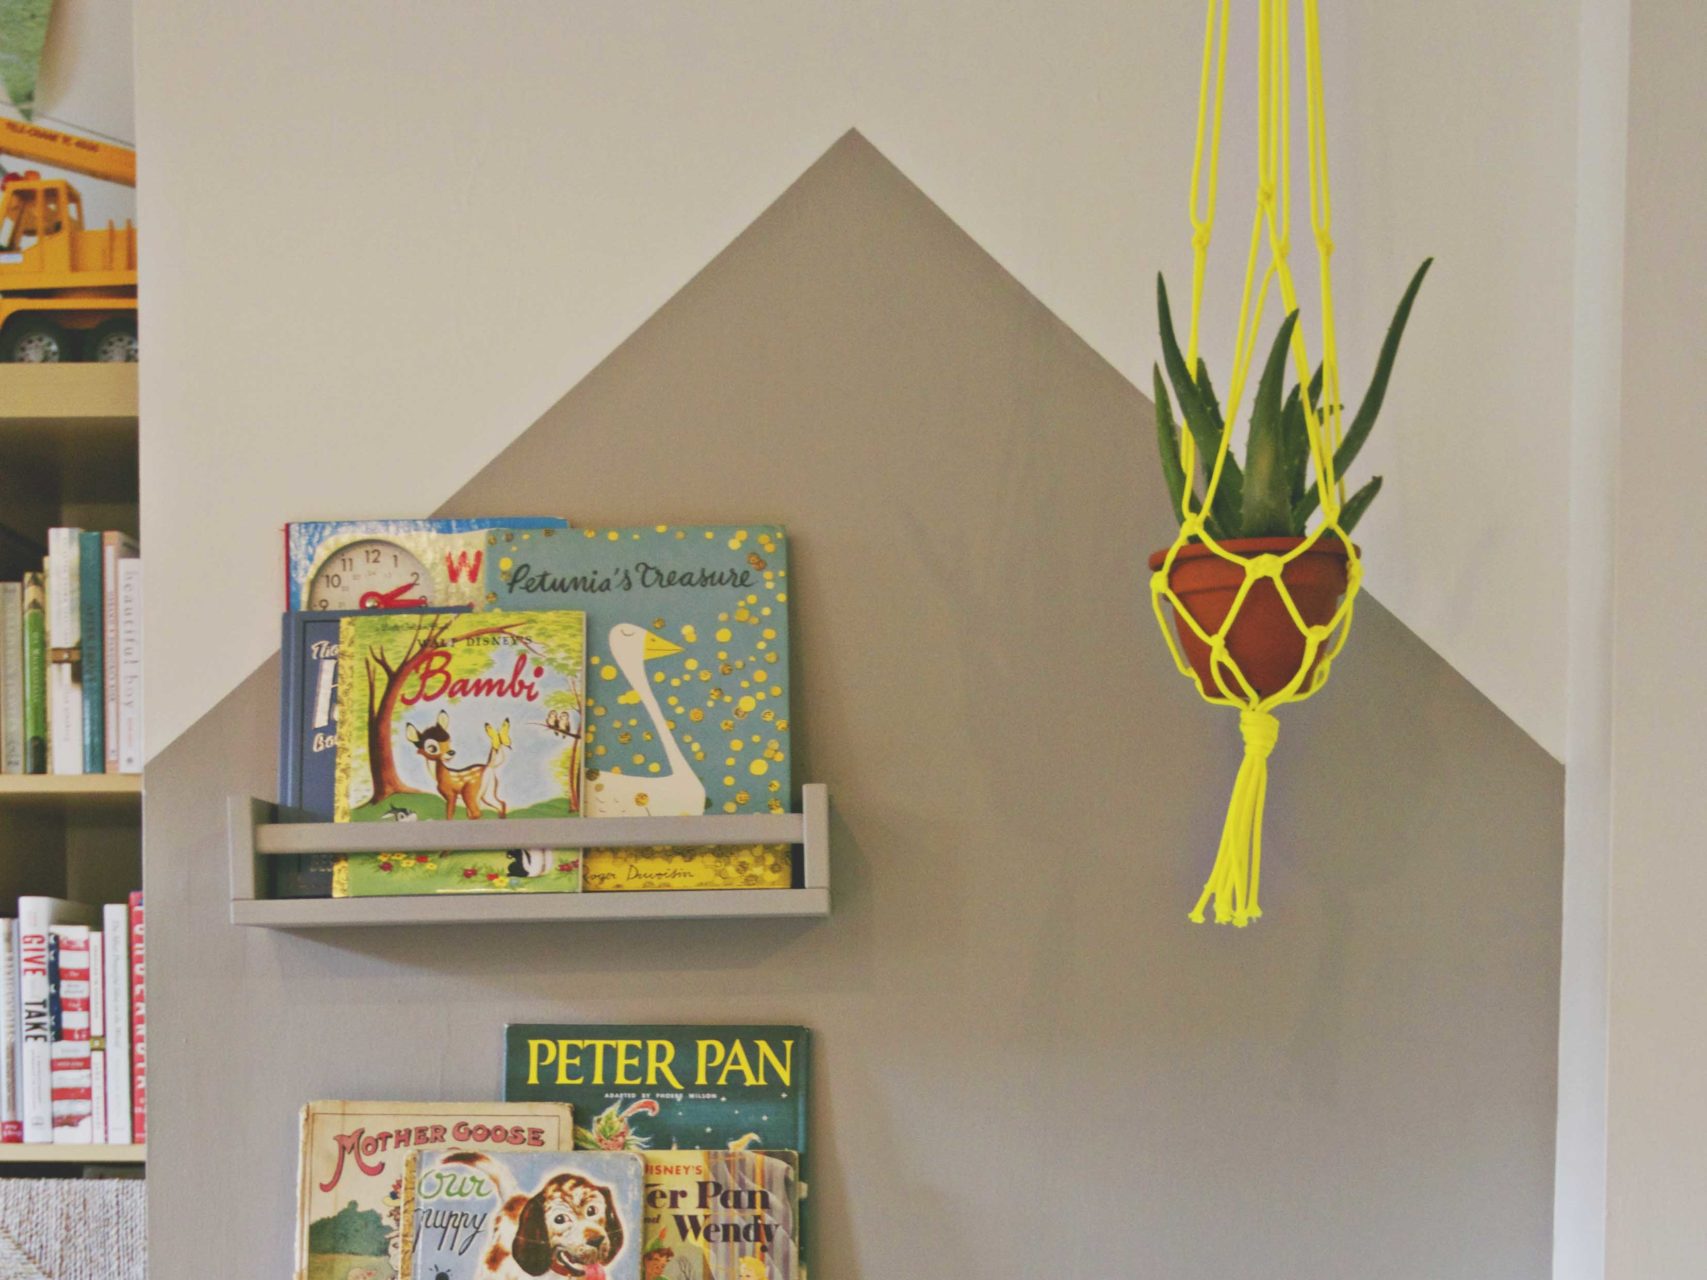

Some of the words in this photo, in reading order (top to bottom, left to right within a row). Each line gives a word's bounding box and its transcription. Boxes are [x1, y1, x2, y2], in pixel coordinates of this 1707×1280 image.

[341, 557, 353, 571] 11
[365, 550, 381, 564] 12
[393, 555, 398, 568] 1
[325, 574, 341, 588] 10
[411, 572, 421, 586] 2
[507, 563, 632, 594] Petunia's
[635, 562, 756, 588] Treasure
[418, 636, 457, 648] WALT
[401, 650, 544, 705] Bambi
[22, 934, 46, 976] GIVE
[25, 1000, 48, 1042] TAKE
[527, 1039, 684, 1089] PETER
[695, 1039, 793, 1087] PAN
[320, 1124, 446, 1192] MOTHER
[452, 1121, 545, 1147] GOOSE
[696, 1181, 771, 1209] Pan
[672, 1214, 779, 1253] Wendy
